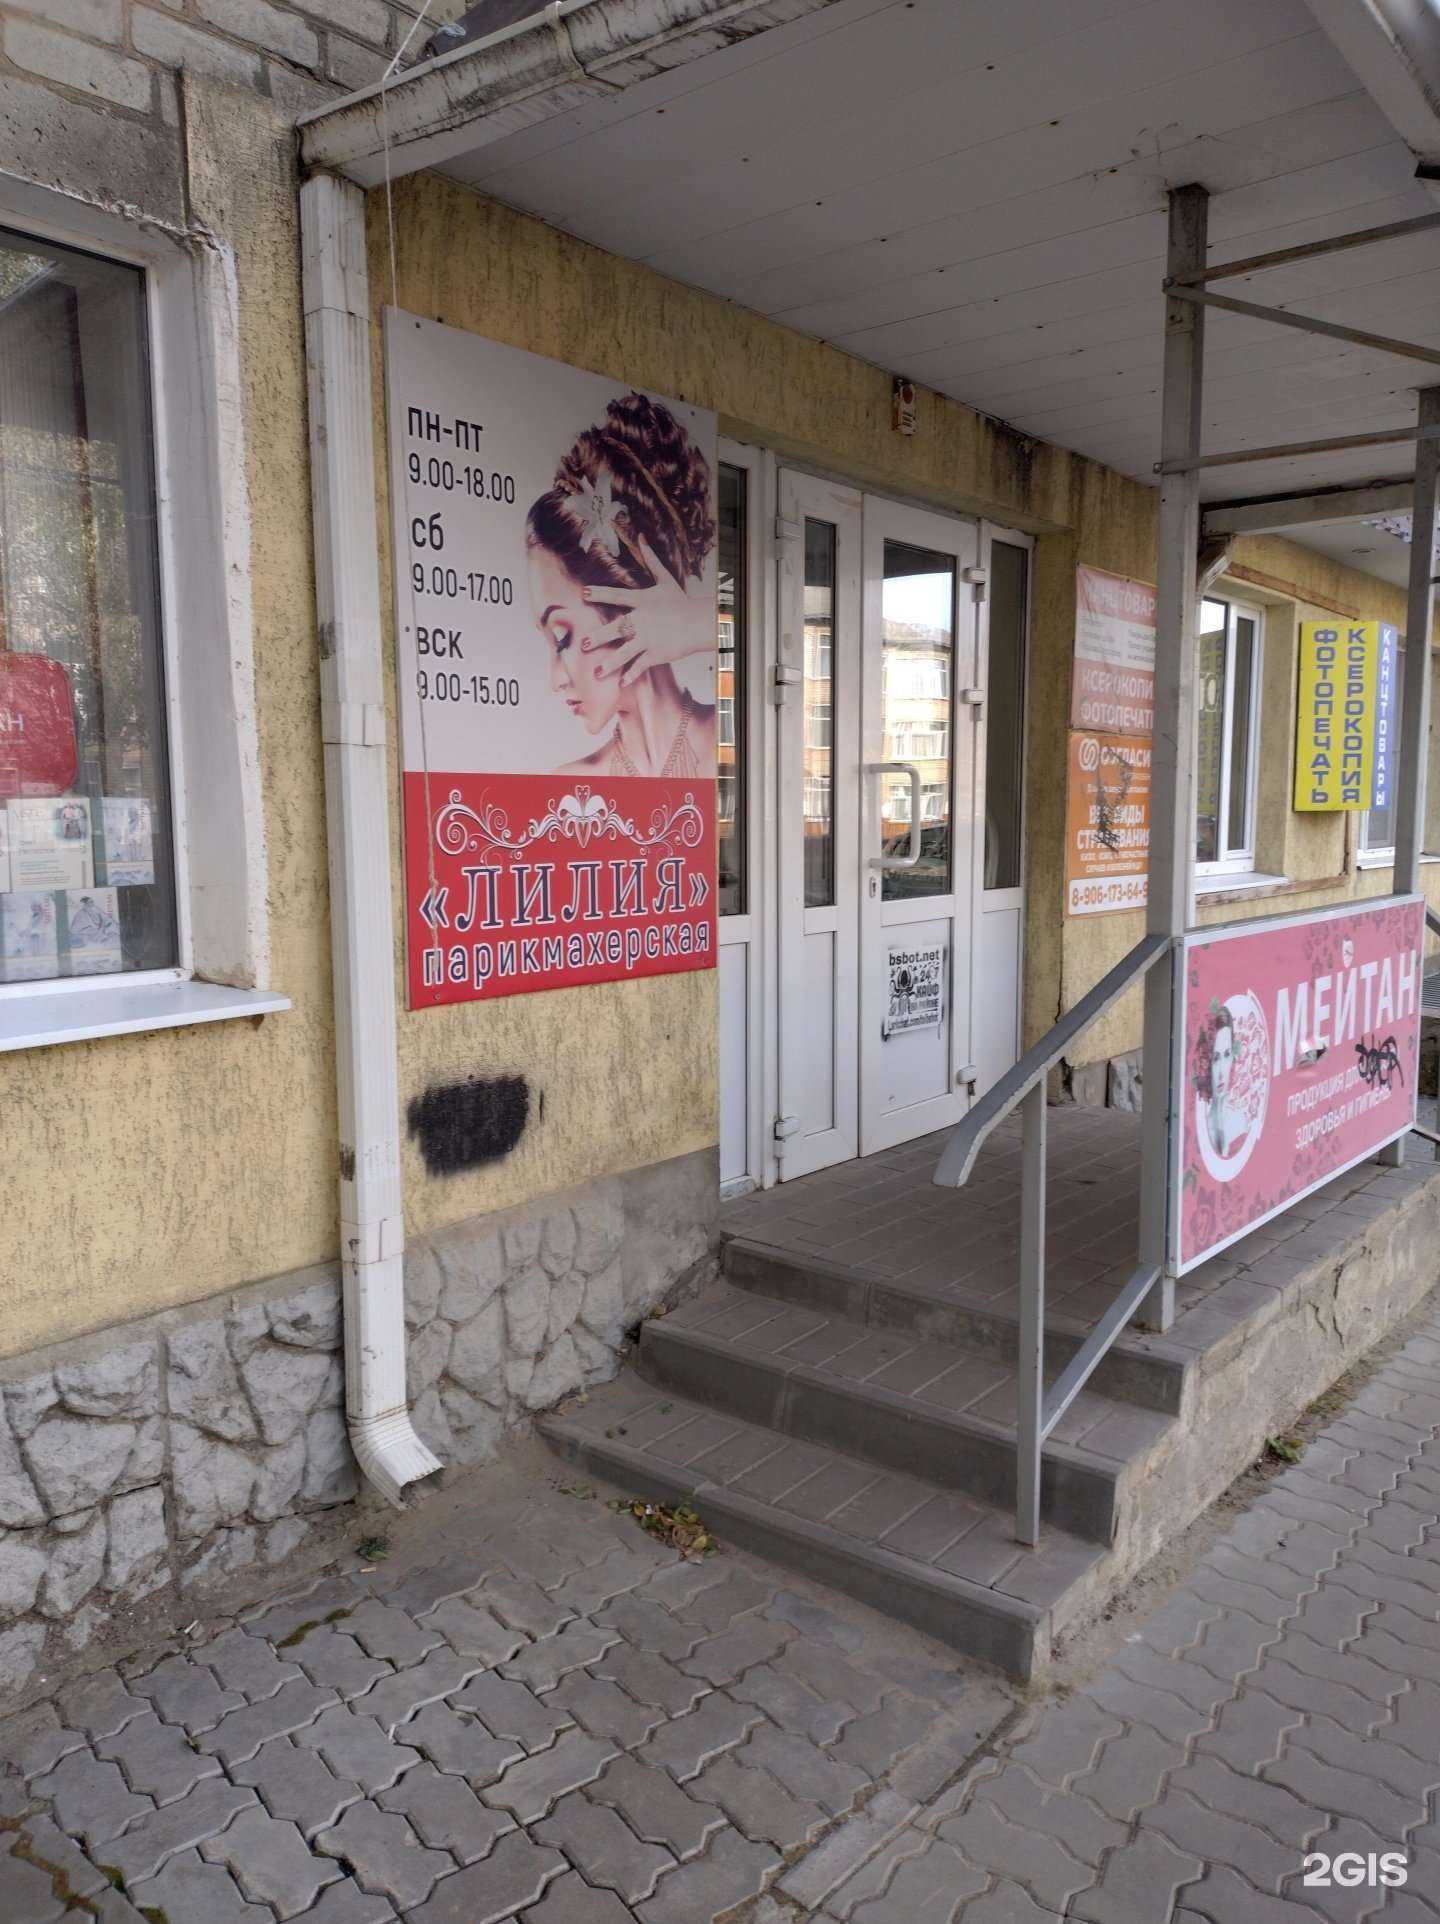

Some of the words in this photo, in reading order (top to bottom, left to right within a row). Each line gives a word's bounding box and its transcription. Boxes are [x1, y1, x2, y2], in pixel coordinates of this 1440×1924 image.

[409, 453, 515, 504] 9.00-18.00
[412, 562, 513, 605] 9.00-17.00
[416, 670, 520, 706] 9.00-15.00
[1081, 670, 1153, 700] КСЕРОКОПИ
[1080, 702, 1153, 729] ФОТОПЕЧАТ
[1310, 628, 1338, 804] ФОТОПЕЧАТЬ
[1340, 628, 1366, 803] КСЕРОКОПИЯ
[1376, 628, 1392, 805] КАНЦТОВАРЫ
[1101, 745, 1151, 768] СОГЛАСИ
[419, 857, 709, 932] «ЛИЛИЯ»
[1072, 880, 1150, 906] 8-906-173-64-9
[423, 921, 710, 989] парикмахерская
[889, 949, 939, 966] bsbot.net
[1272, 939, 1416, 1077] МЕЙТАН
[1287, 1072, 1344, 1117] ПРОДУКЦИЯ
[1295, 1104, 1346, 1150] ЗДОРОВЬЯ
